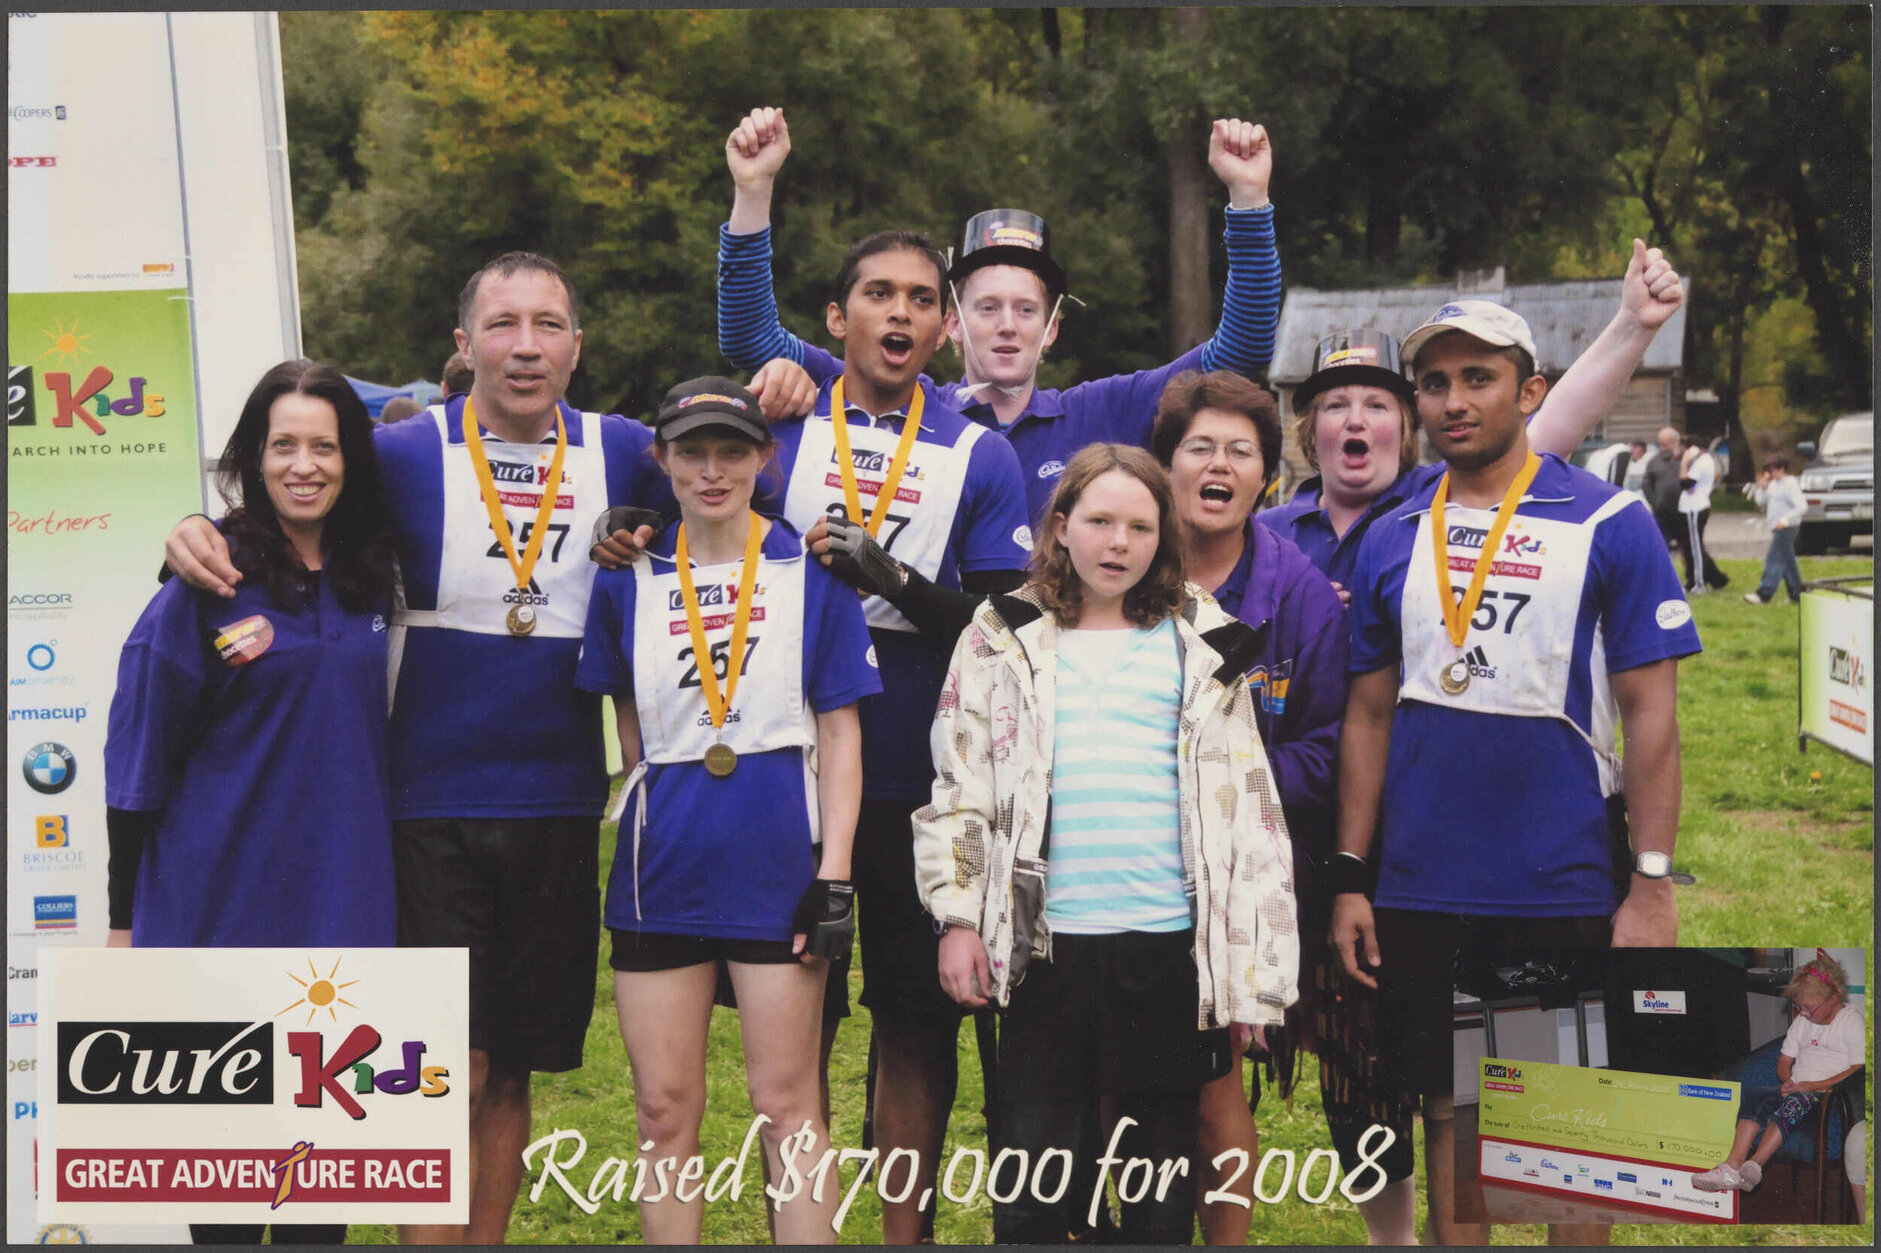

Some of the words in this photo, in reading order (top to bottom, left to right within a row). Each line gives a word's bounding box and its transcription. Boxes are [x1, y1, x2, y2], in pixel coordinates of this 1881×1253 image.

[44, 365, 166, 436] Kids
[69, 444, 111, 456] INTO
[120, 442, 168, 454] HOPE
[834, 453, 881, 469] ure
[1449, 527, 1488, 547] Cur
[9, 593, 72, 605] ACCOR
[671, 584, 721, 608] Cre
[10, 678, 27, 686] AIM
[26, 742, 74, 761] BMW
[24, 852, 85, 865] BRISCOE
[37, 902, 73, 910] COLLIERS
[1643, 1000, 1669, 1009] Skyline
[9, 1010, 38, 1024] arv
[1714, 1090, 1731, 1099] Zealand
[1484, 1119, 1492, 1127] The
[1530, 1104, 1569, 1121] Cure
[1571, 1108, 1607, 1131] Kids
